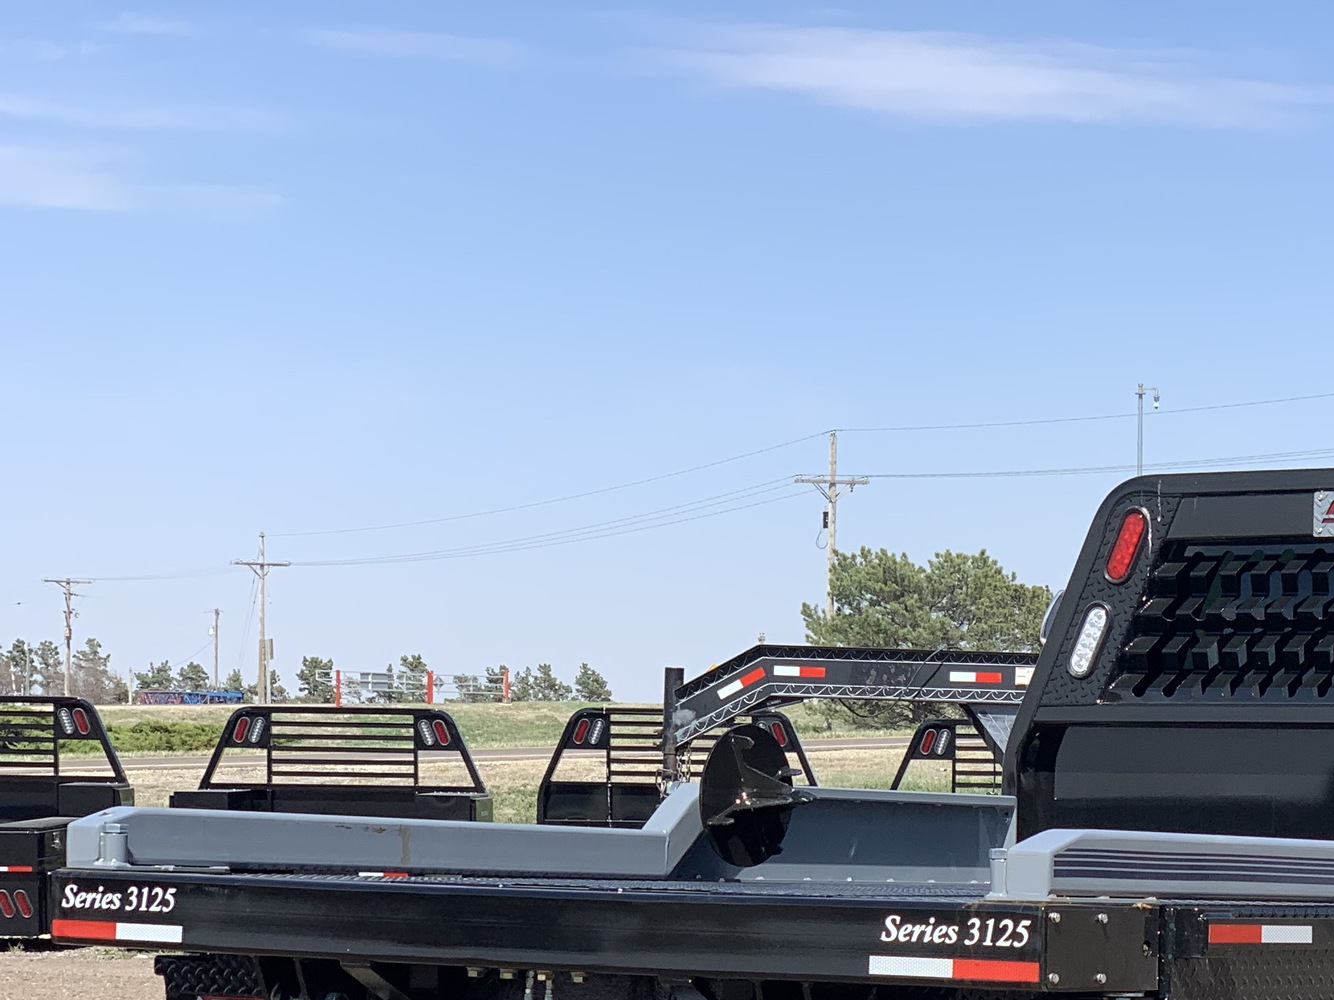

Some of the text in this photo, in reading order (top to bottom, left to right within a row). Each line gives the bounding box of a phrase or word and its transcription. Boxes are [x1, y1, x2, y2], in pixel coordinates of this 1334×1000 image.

[61, 884, 178, 913] Series 3125
[879, 914, 1032, 949] Series 3125
